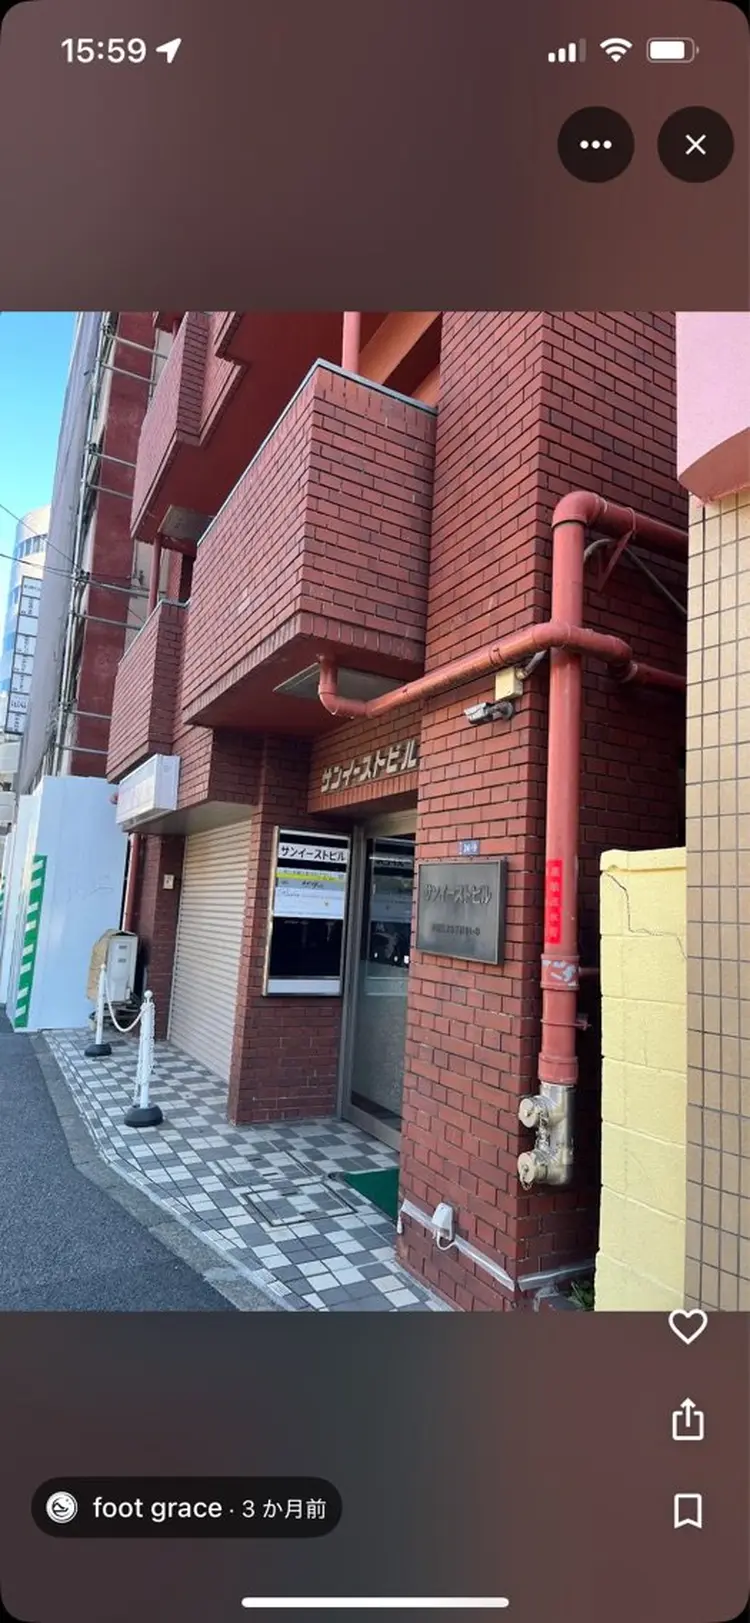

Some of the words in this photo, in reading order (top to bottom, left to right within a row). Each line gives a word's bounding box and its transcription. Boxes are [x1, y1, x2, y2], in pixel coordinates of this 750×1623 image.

[321, 739, 417, 793] サンイーストビル
[281, 845, 345, 861] サンイーストビル
[425, 883, 492, 904] サンイーストビル
